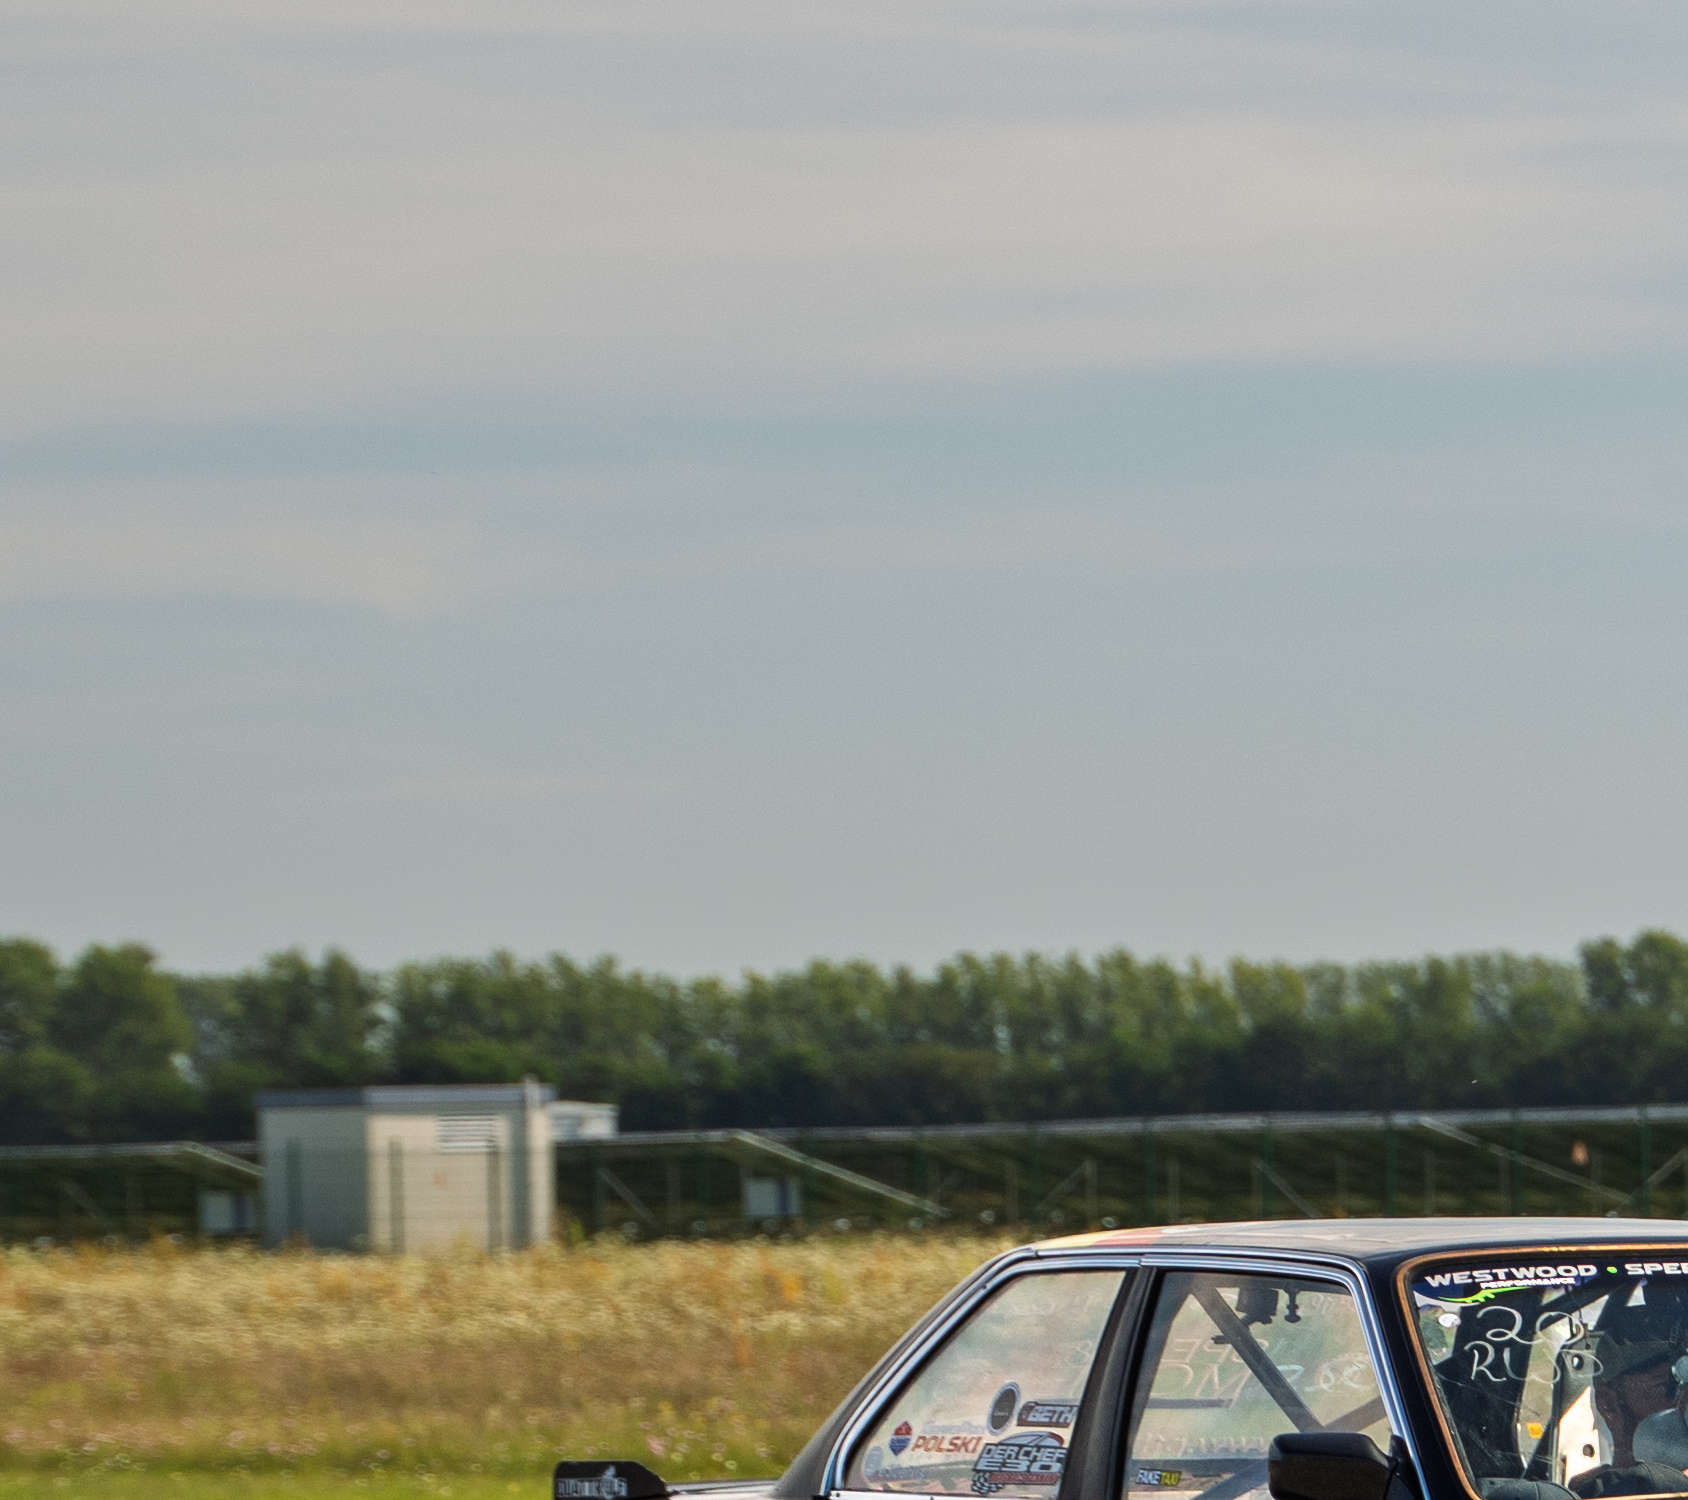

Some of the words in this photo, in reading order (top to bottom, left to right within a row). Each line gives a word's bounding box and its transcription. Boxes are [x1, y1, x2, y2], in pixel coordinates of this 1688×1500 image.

[1424, 1264, 1598, 1288] WESTWOOD
[1479, 1277, 1576, 1289] PERFORMANCE
[911, 1435, 985, 1453] POLSKI
[982, 1443, 1017, 1460] DER
[1018, 1446, 1068, 1462] CHEF
[977, 1459, 1063, 1473] E30
